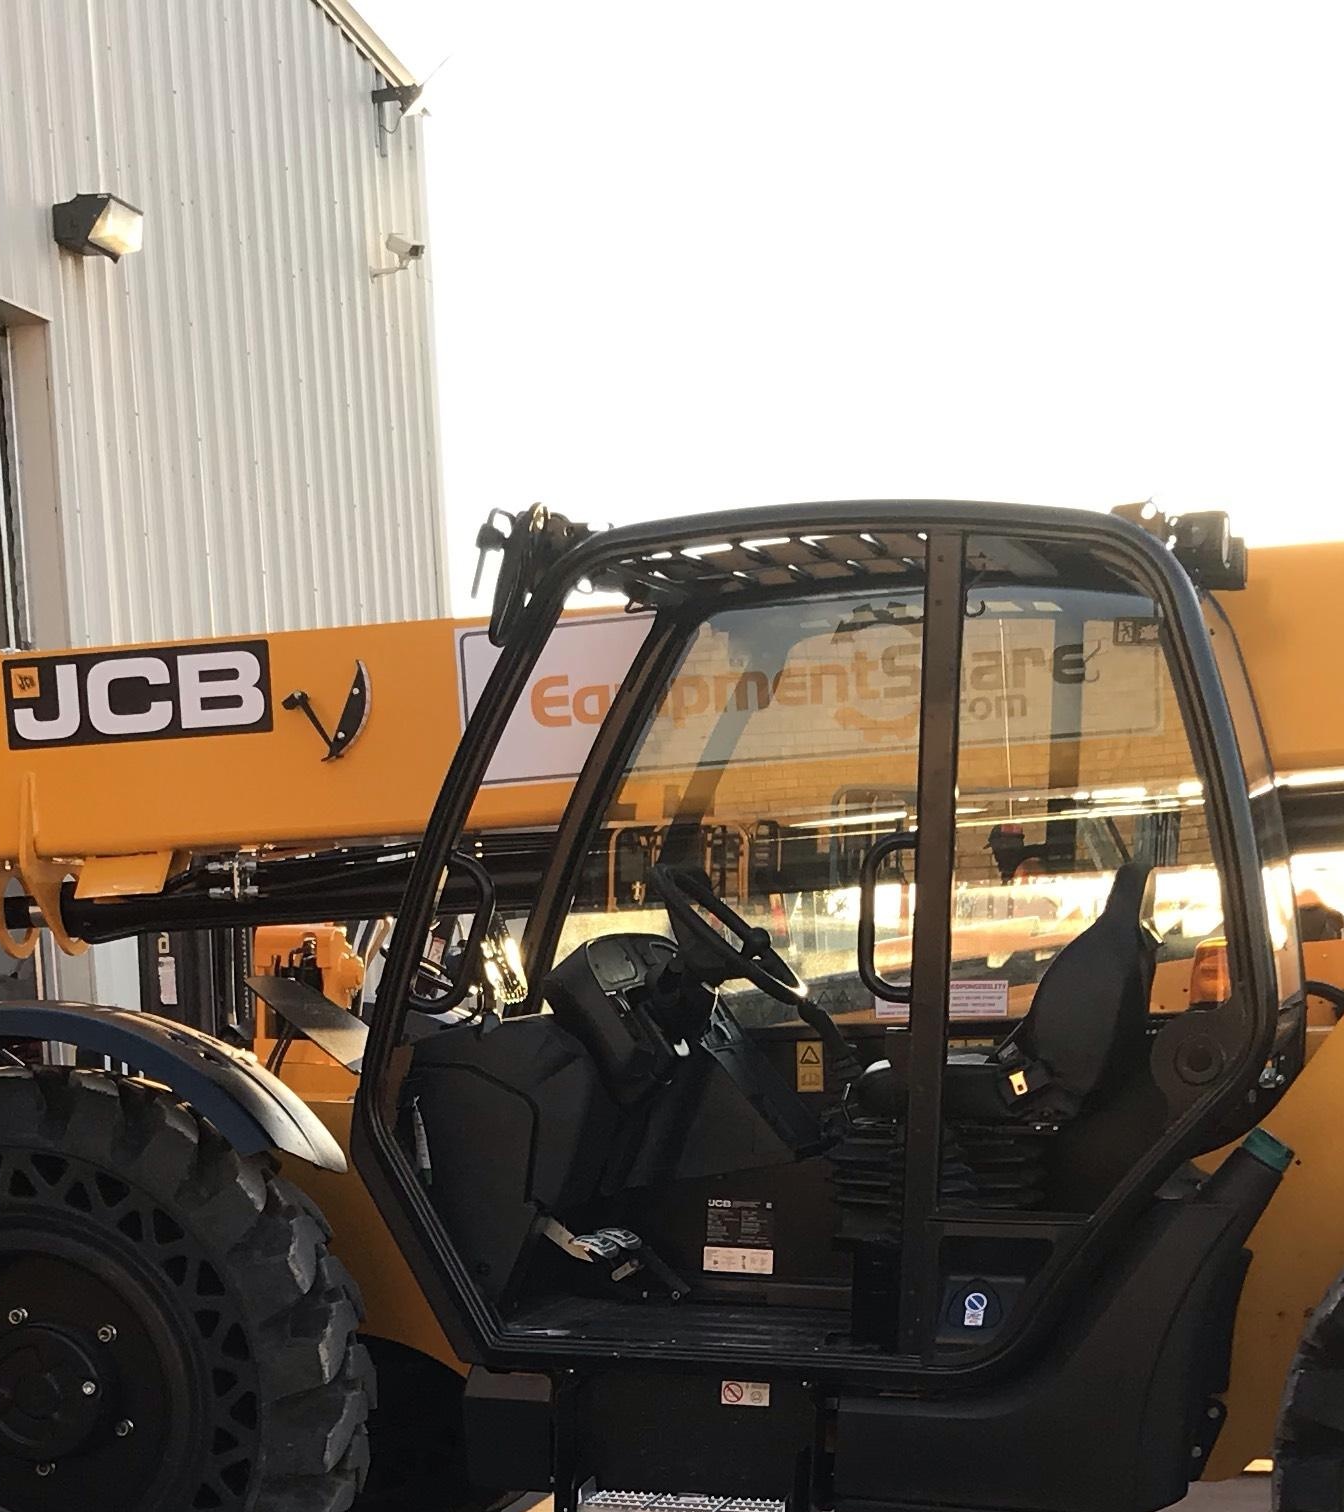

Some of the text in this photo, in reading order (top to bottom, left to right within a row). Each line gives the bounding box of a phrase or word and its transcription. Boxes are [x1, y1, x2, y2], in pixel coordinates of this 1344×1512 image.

[13, 650, 265, 741] JCB
[530, 642, 1086, 729] EqpmentSare
[707, 1199, 732, 1208] JCB
